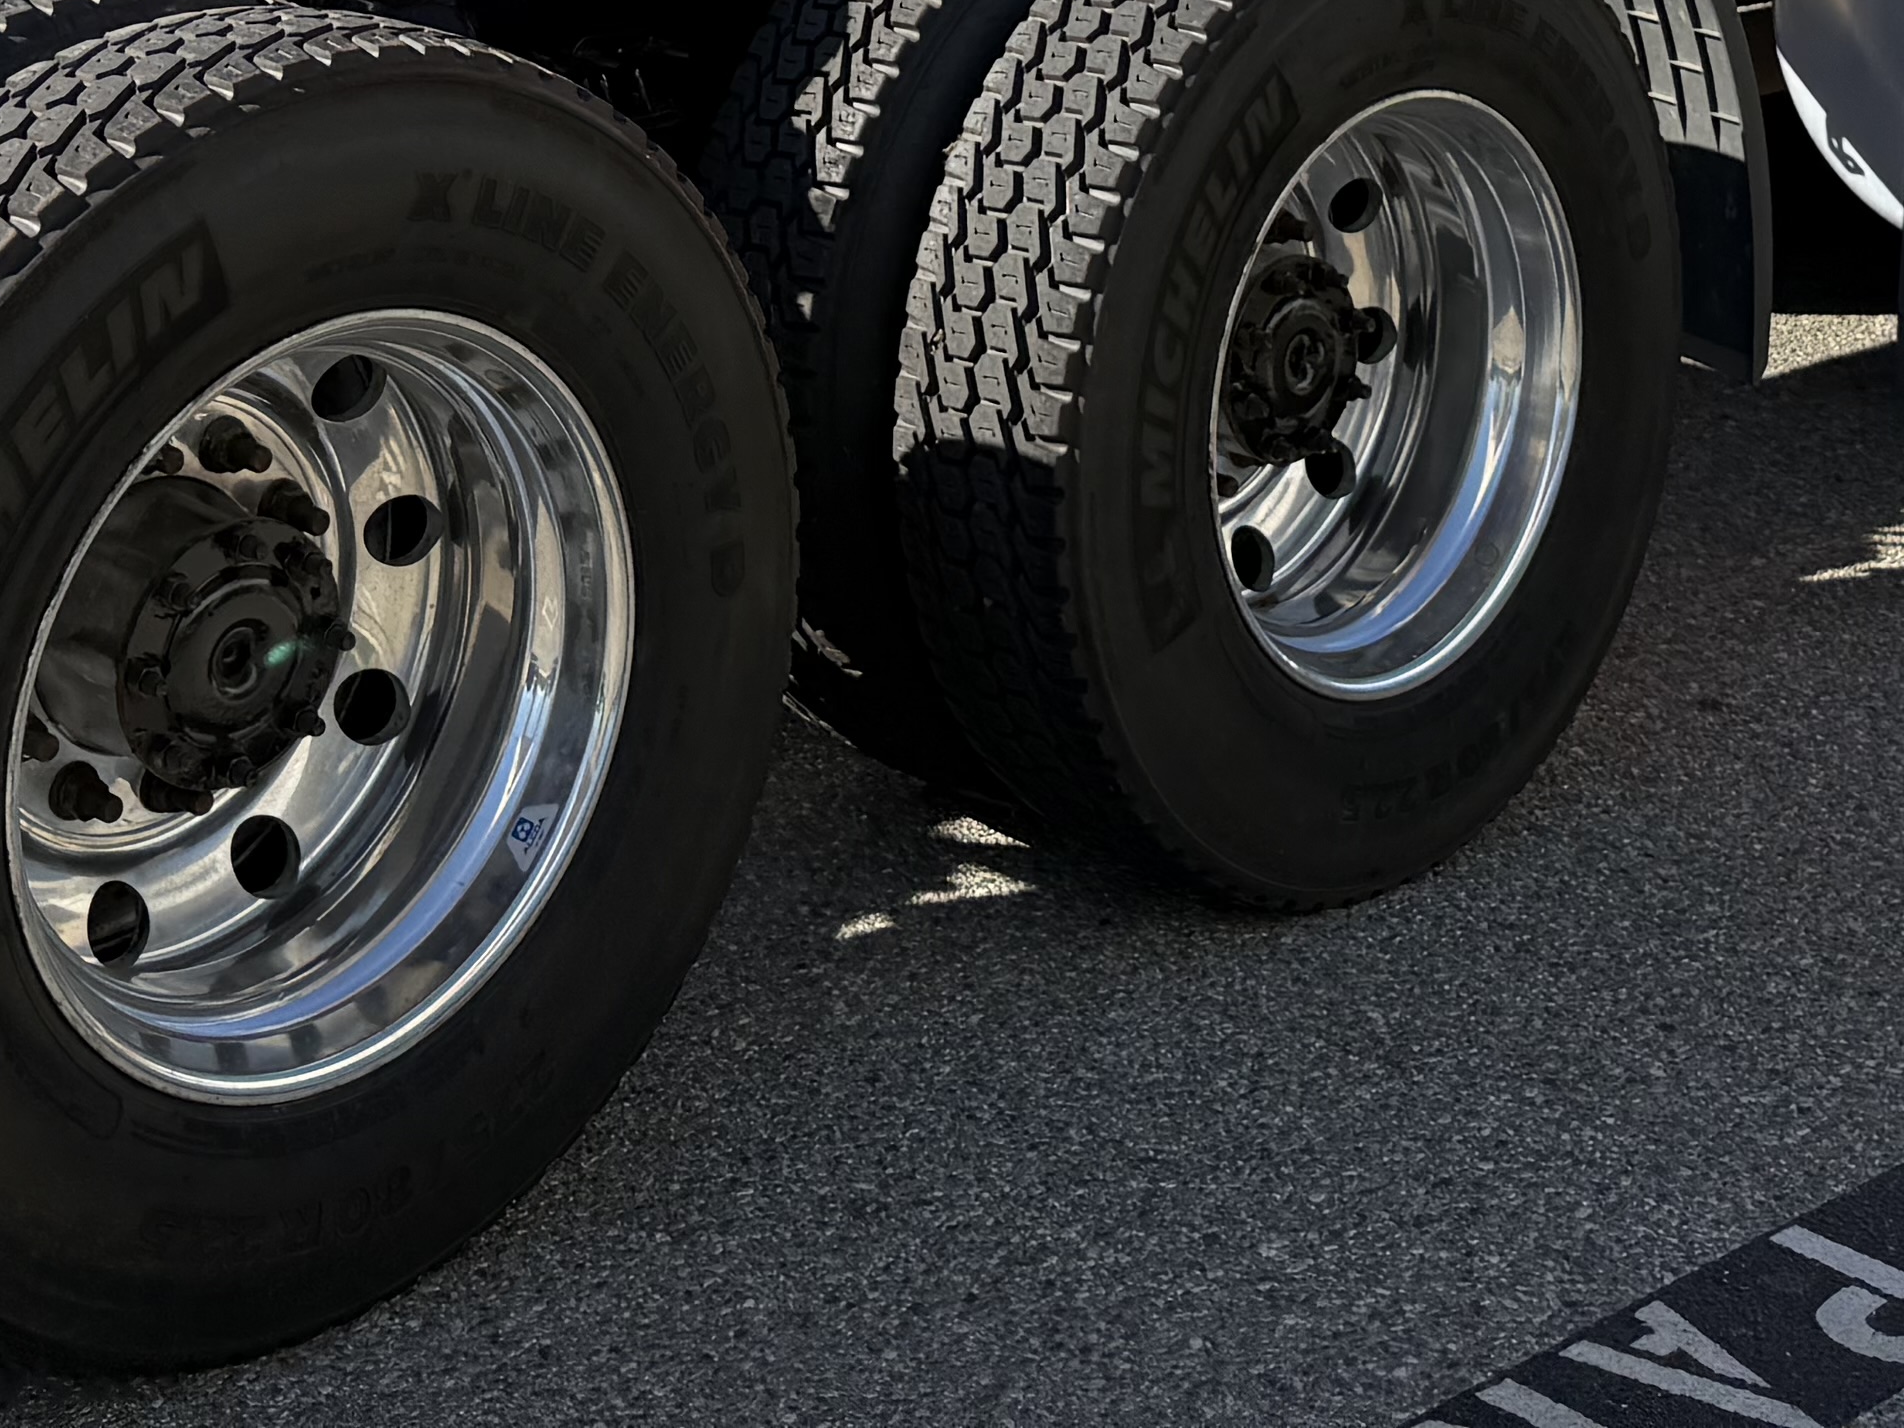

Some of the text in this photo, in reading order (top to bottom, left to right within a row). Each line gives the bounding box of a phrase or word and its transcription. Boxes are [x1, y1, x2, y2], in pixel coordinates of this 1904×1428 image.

[471, 177, 607, 274] LINE
[602, 249, 742, 512] ENERGY
[1139, 69, 1291, 509] MICHELIN
